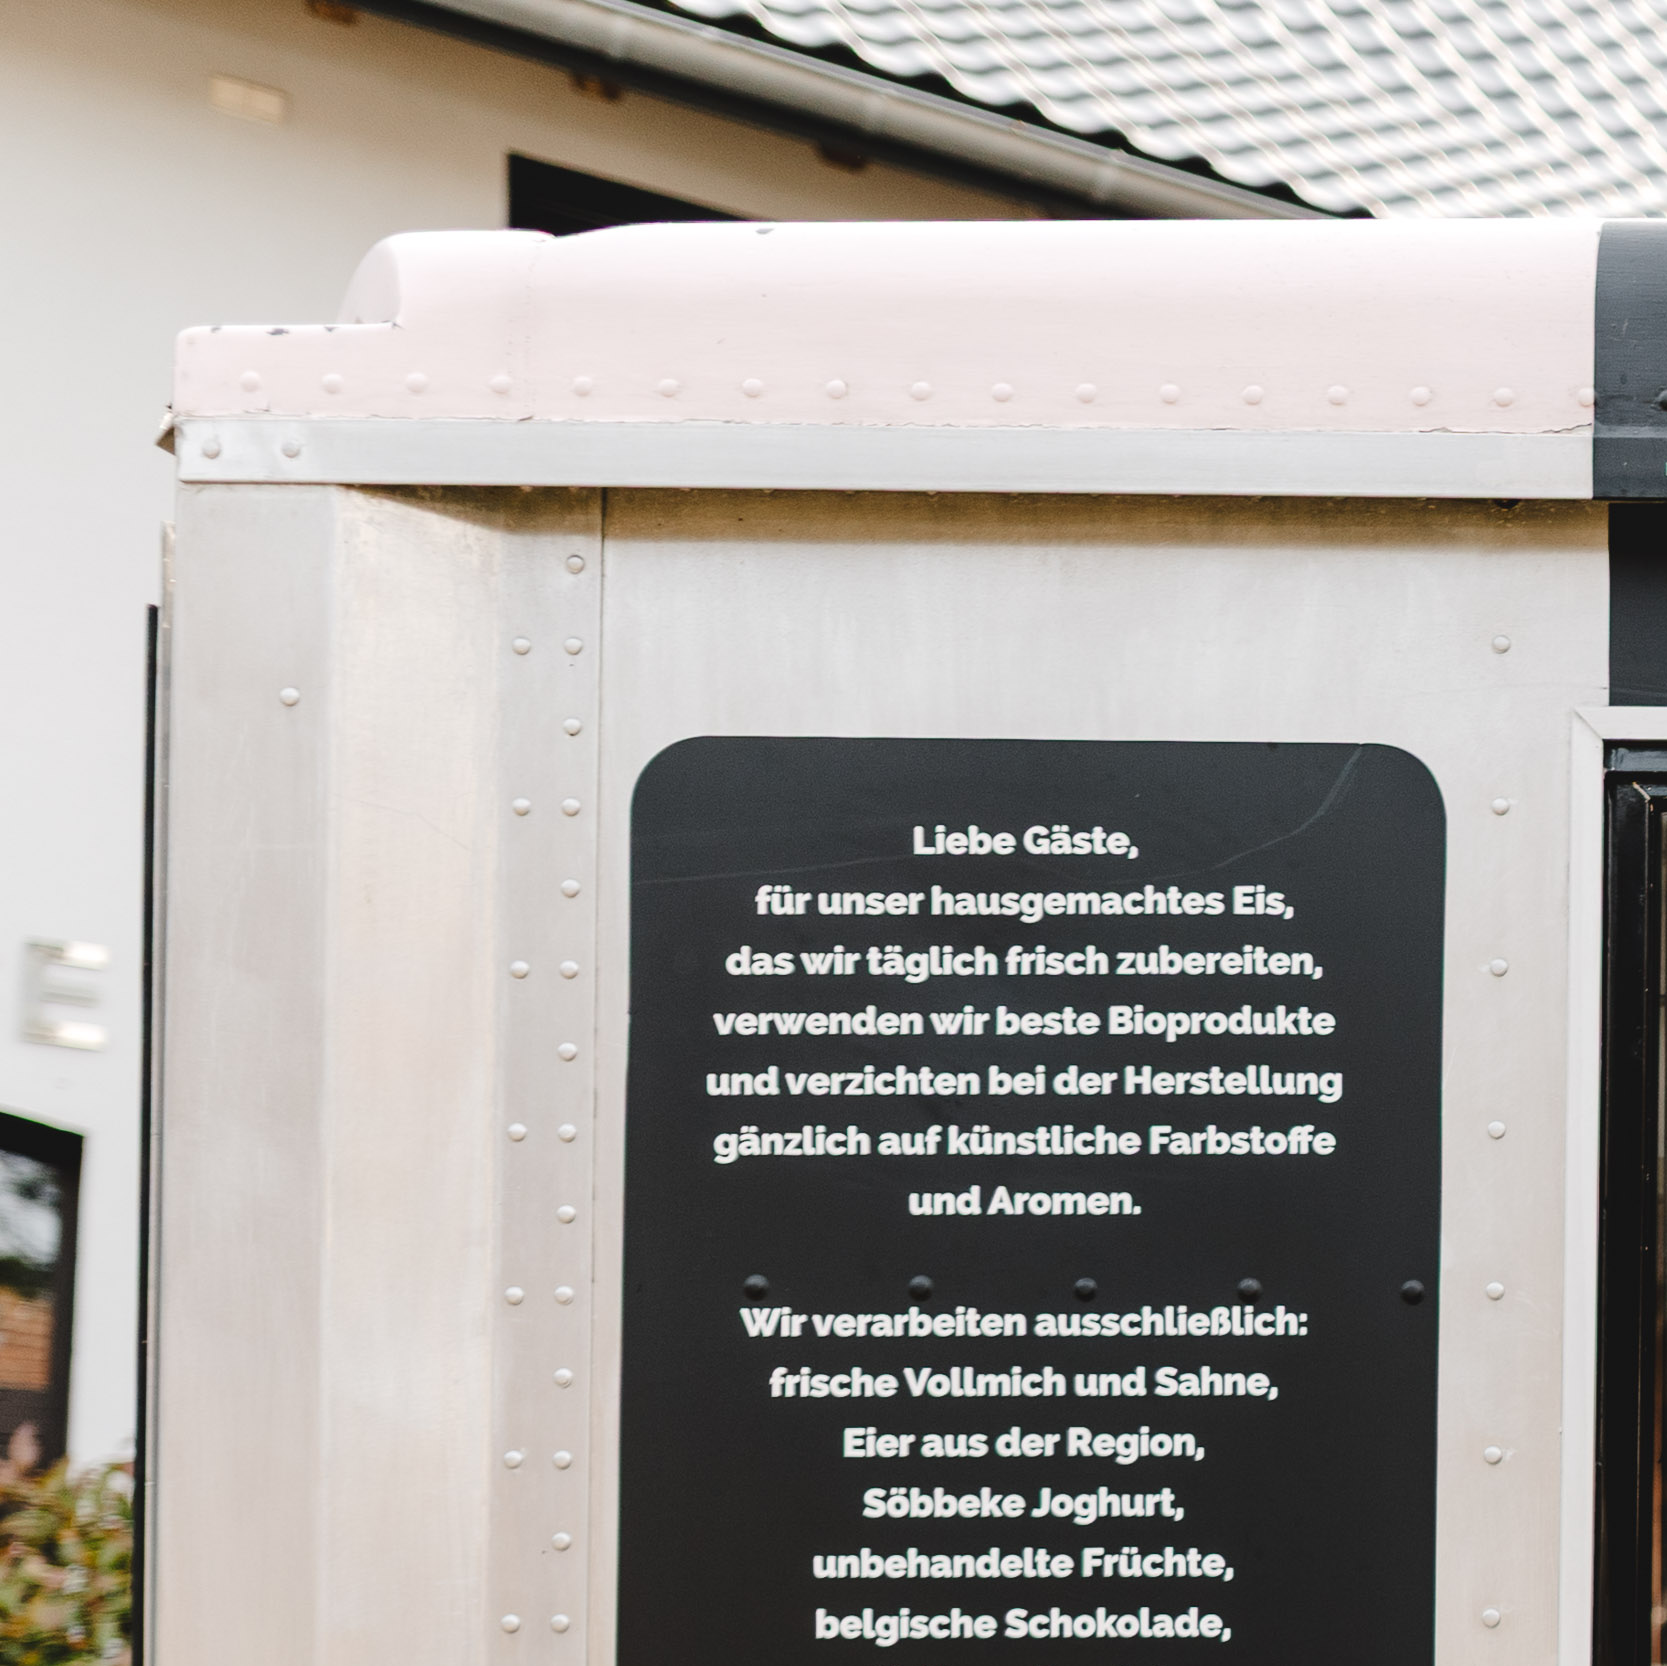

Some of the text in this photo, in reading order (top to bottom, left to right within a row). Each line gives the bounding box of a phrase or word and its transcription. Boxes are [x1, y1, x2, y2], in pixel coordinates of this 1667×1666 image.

[913, 824, 1139, 860] Liebe Gäste,
[754, 884, 1295, 924] für unser hausgemachtes Eis,
[725, 944, 1323, 984] das wir täglich frisch zubereiten,
[712, 1004, 1337, 1043] verwenden wir beste Bioprodukte
[706, 1064, 1343, 1104] und verzichten bei der Herstellung
[713, 1124, 1337, 1165] gänzlich auf künstliche Farbstoffe
[908, 1184, 1142, 1216] und Aromen.
[739, 1305, 1308, 1338] Wir verarbeiten ausschließlich:
[768, 1365, 1279, 1401] frische Vollmich und Sahne,
[843, 1425, 1205, 1465] Eier aus der Region,
[862, 1486, 1185, 1526] Söbbeke Joghurt,
[812, 1546, 1234, 1582] unbehandelte Früchte,
[815, 1606, 1232, 1647] belgische Schokolade,
